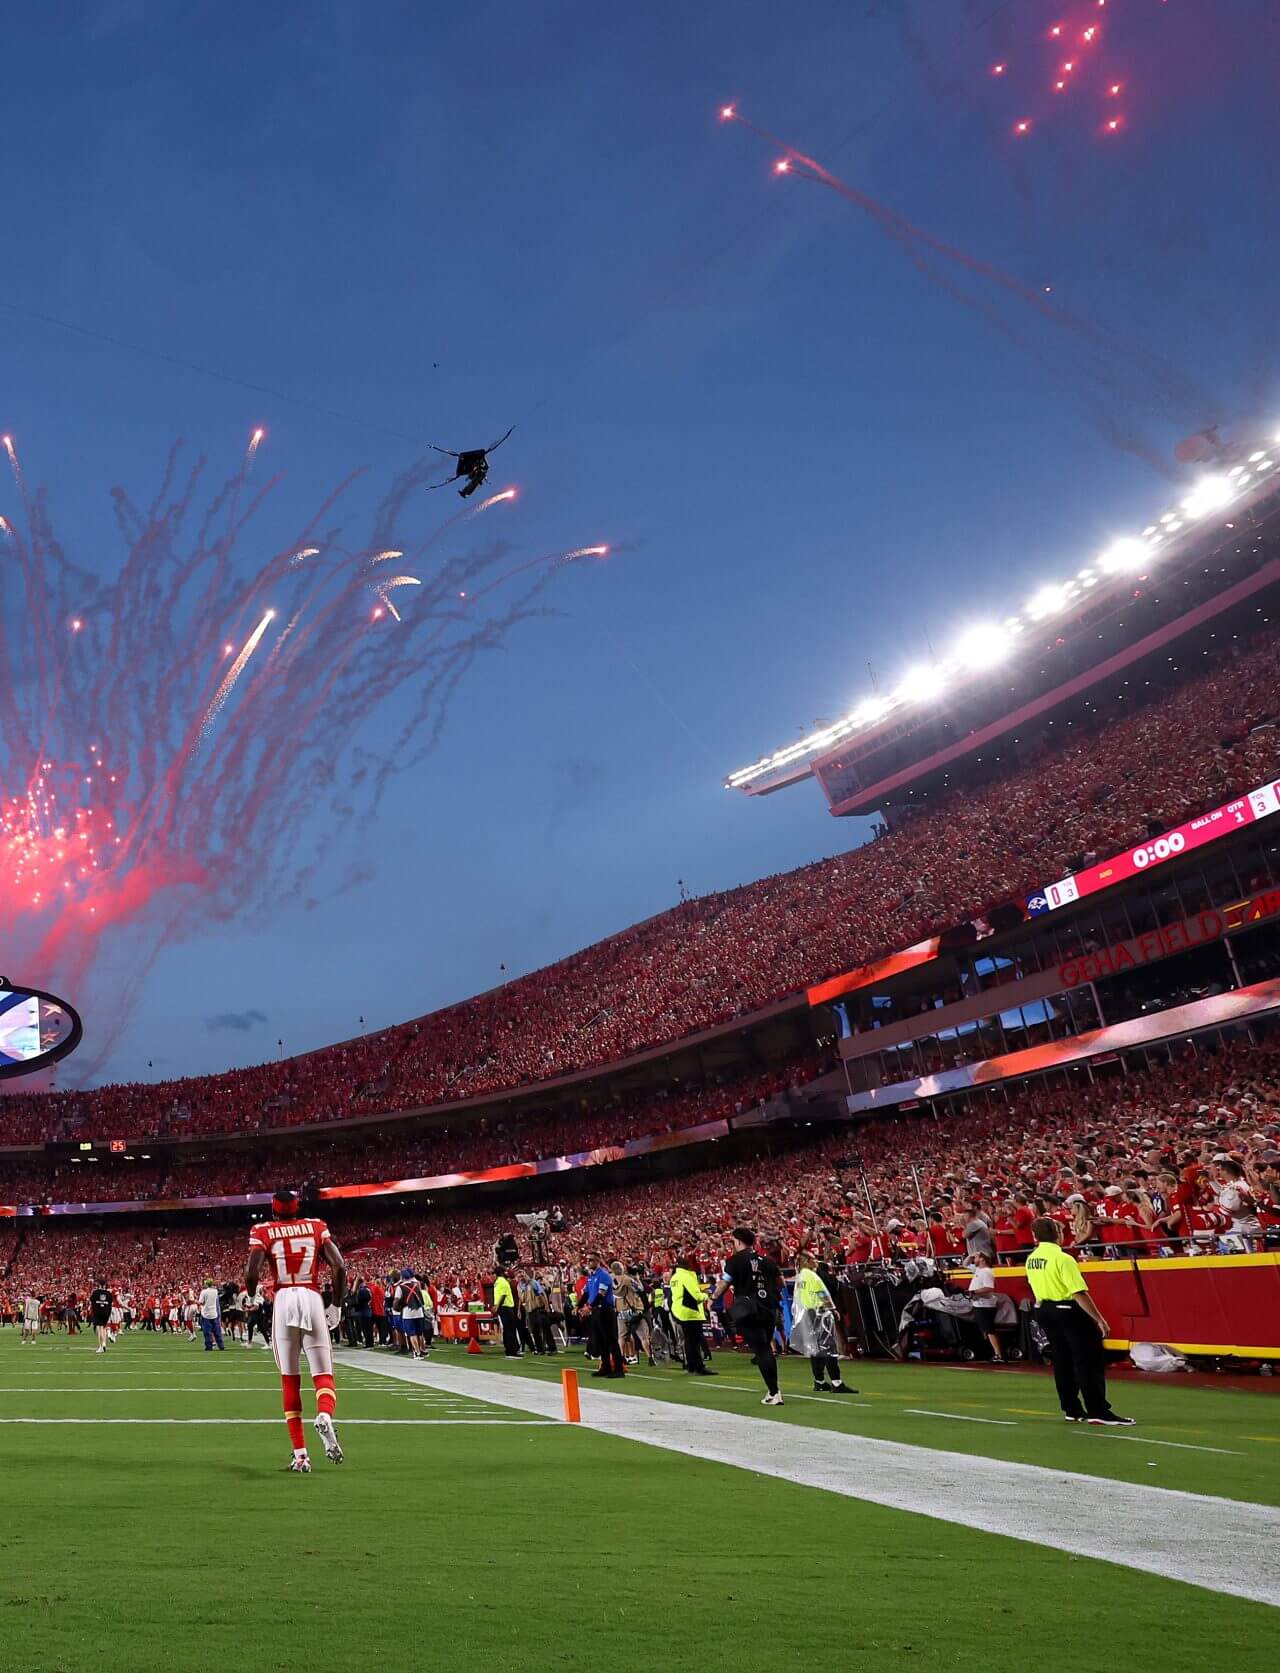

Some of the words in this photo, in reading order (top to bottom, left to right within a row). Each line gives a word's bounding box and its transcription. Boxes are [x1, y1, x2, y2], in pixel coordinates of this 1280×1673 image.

[1227, 801, 1244, 812] QTR
[1257, 802, 1266, 812] 3
[1191, 817, 1211, 830] BALL
[1211, 811, 1223, 820] ON
[1235, 811, 1245, 823] 1
[1133, 832, 1185, 868] 0:00
[1051, 886, 1061, 904] 0
[1067, 889, 1074, 897] 3
[1059, 943, 1136, 987] GEHA
[1137, 911, 1222, 960] FIELD
[112, 1141, 124, 1151] 25
[267, 1223, 315, 1239] HARDMAN
[271, 1237, 316, 1284] 17
[458, 1319, 468, 1332] G
